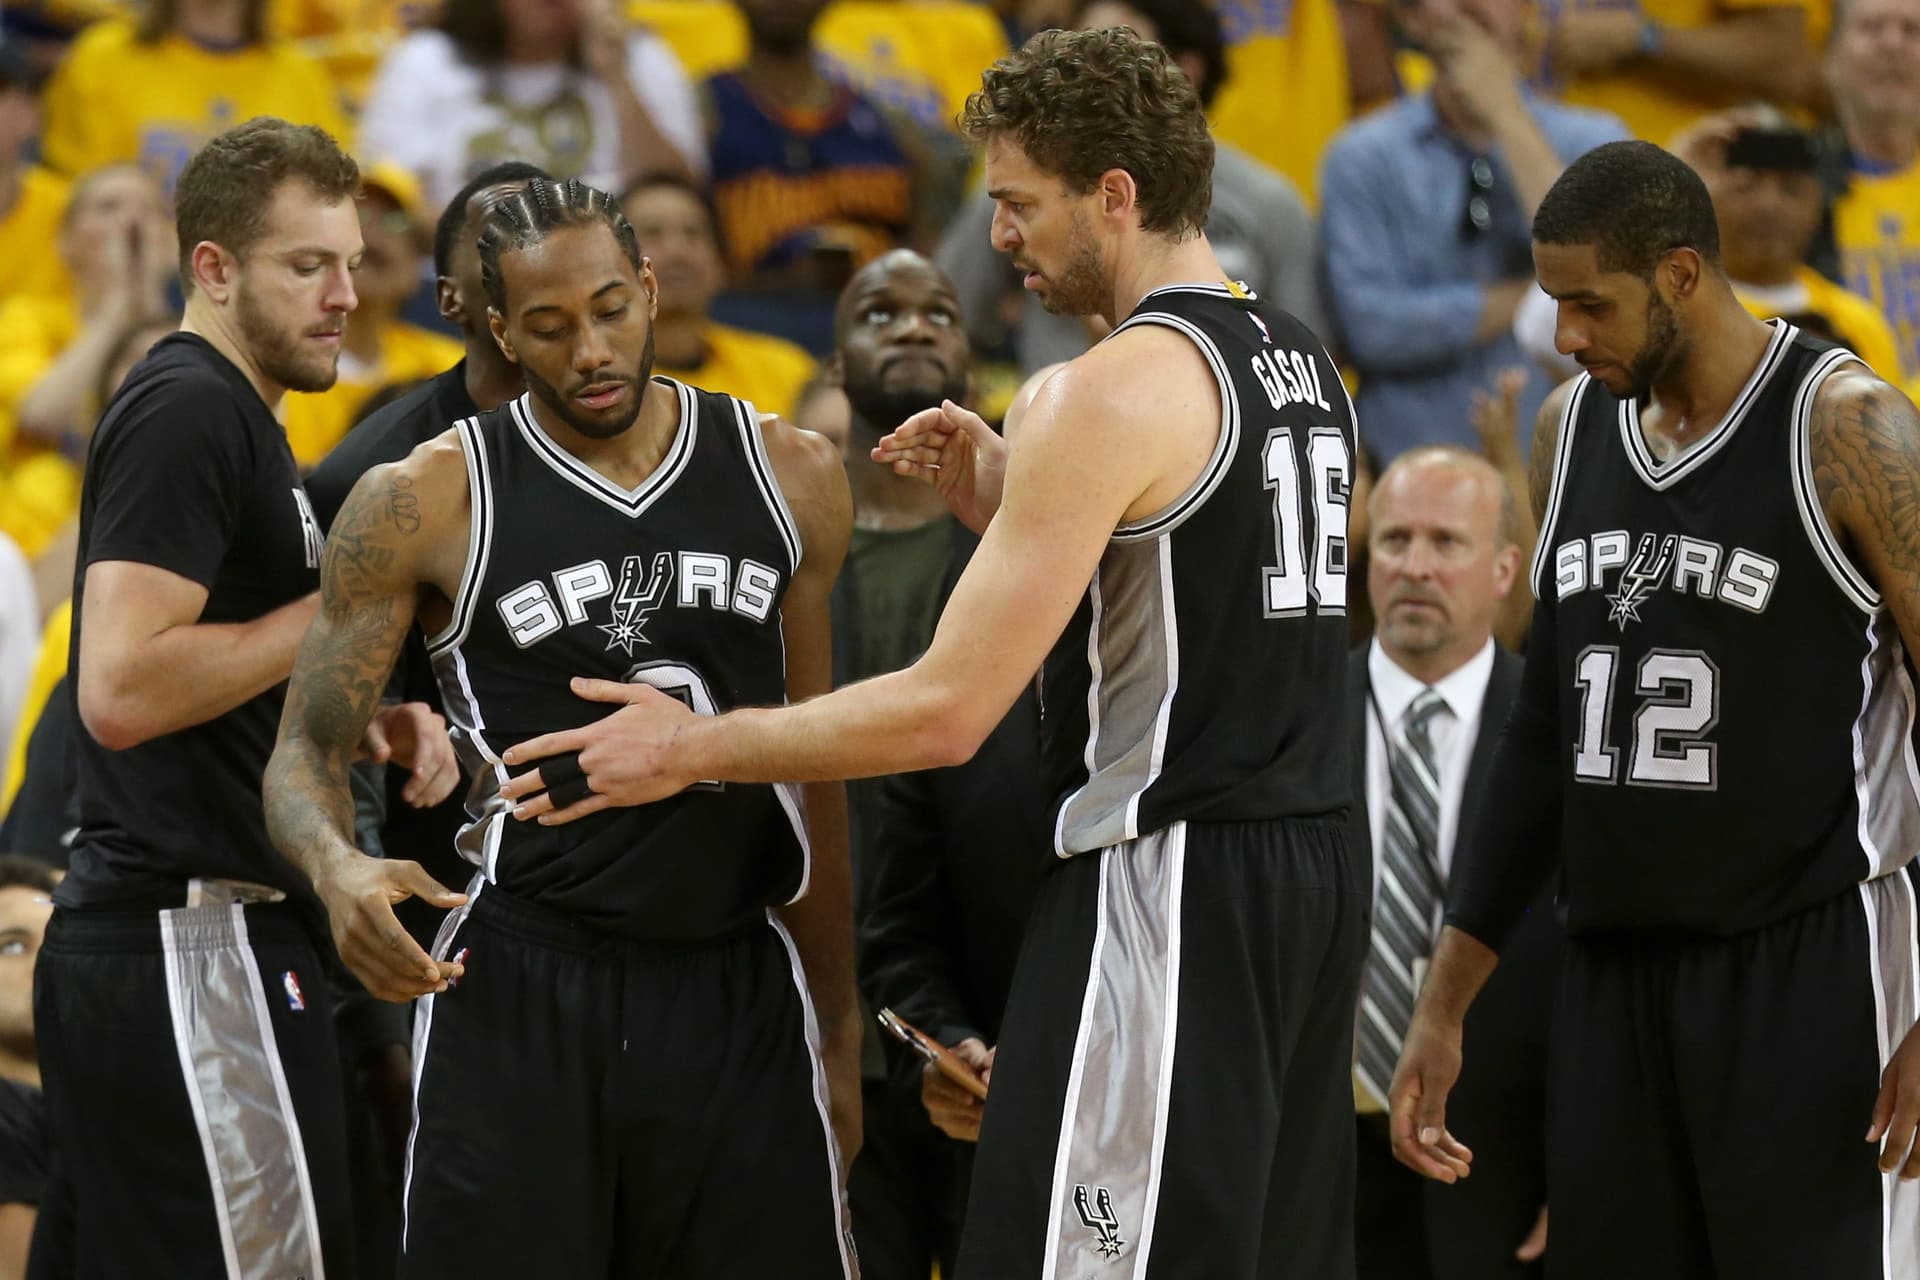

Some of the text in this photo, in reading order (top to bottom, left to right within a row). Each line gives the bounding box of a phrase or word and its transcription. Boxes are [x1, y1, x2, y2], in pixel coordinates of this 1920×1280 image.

[1251, 349, 1331, 412] GASOL
[1261, 427, 1350, 618] 16
[496, 550, 780, 656] SPURS
[1556, 530, 1780, 632] SPURS
[1573, 644, 1720, 791] 12
